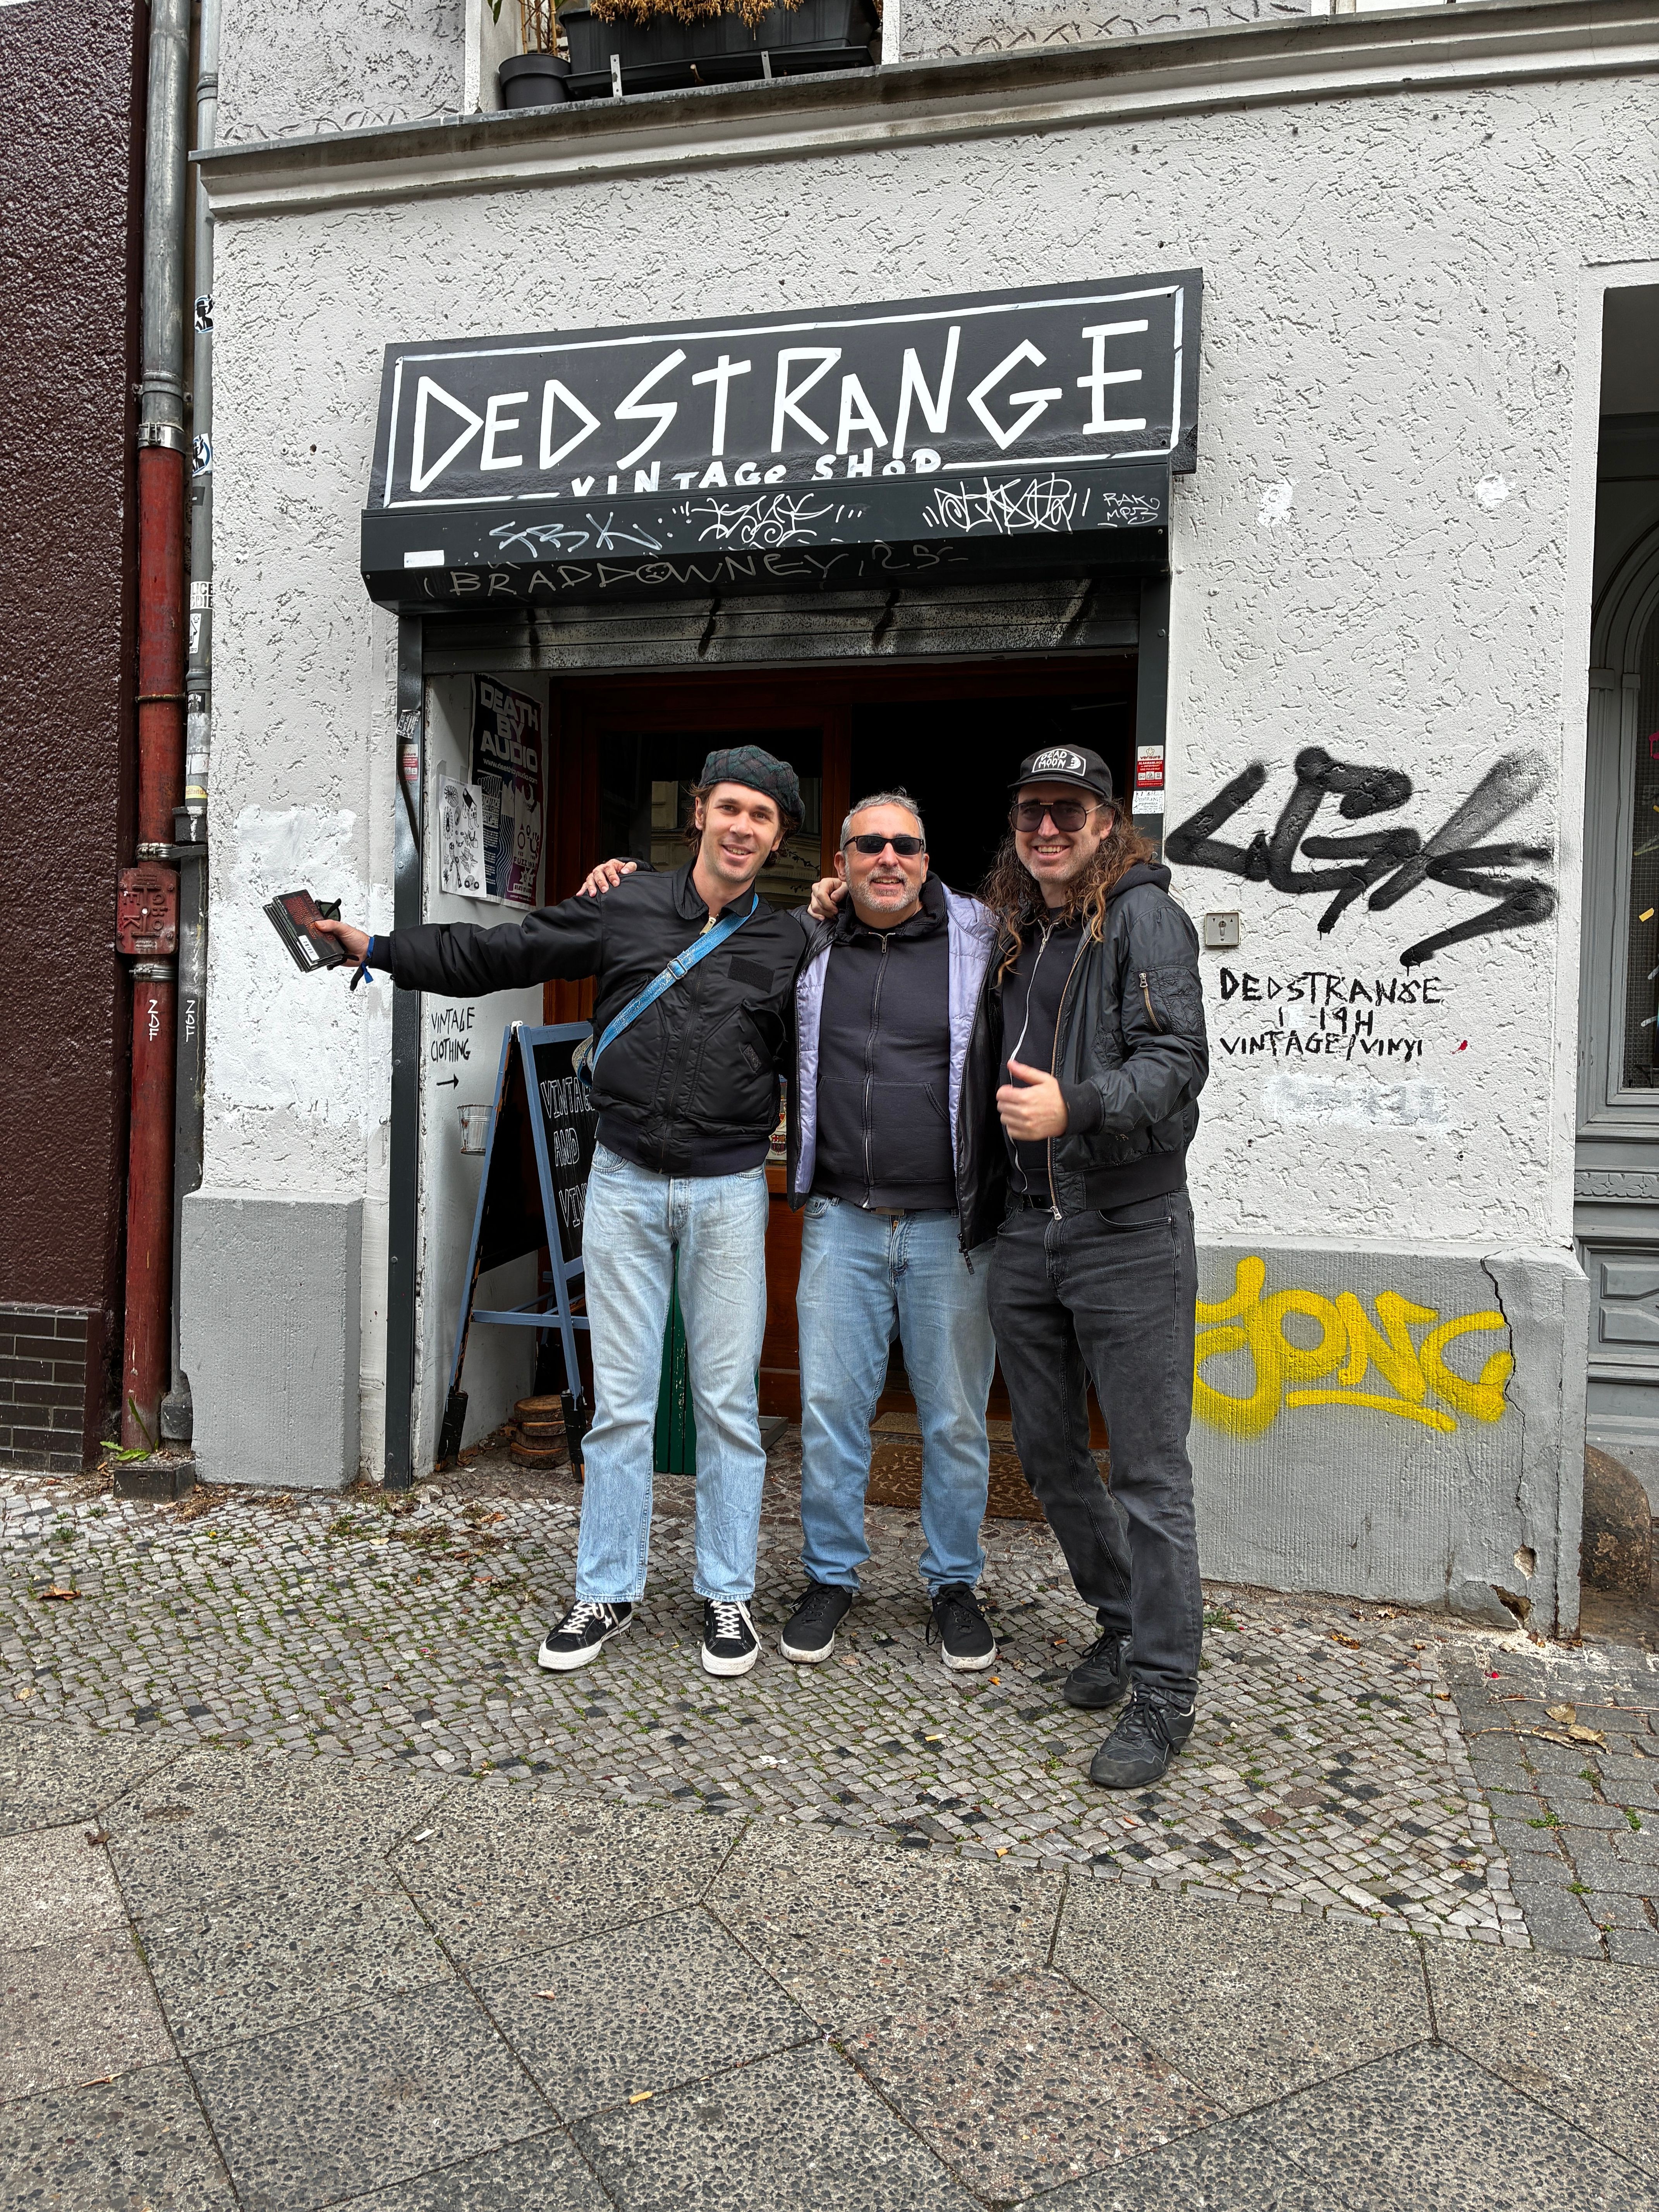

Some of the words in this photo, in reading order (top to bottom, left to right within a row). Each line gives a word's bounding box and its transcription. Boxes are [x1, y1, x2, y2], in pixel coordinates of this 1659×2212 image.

[410, 319, 1148, 492] DEDSTRANGE
[481, 681, 538, 731] DEATH
[497, 713, 524, 743] BY
[481, 730, 538, 773] AUDIO
[1038, 758, 1066, 769] MOON
[1041, 750, 1067, 762] DEAD
[528, 861, 536, 869] WA
[553, 1127, 580, 1168] AND
[559, 1182, 588, 1228] VIN
